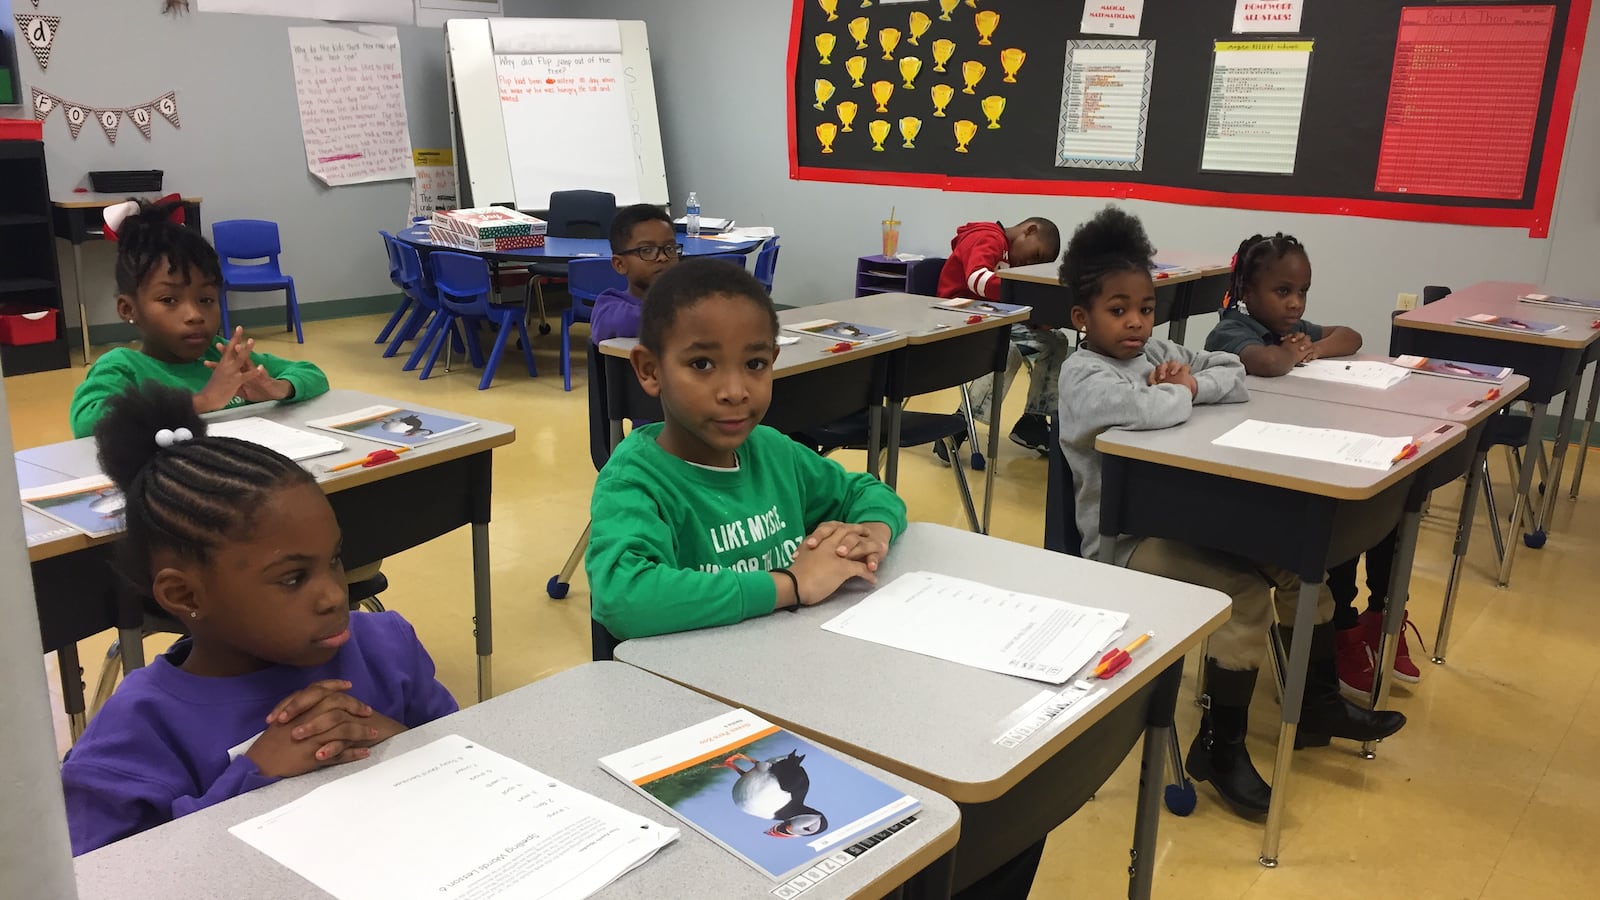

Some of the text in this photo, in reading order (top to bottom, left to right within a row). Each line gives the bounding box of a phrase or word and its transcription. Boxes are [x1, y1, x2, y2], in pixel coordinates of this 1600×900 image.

[1426, 9, 1452, 24] Read
[499, 56, 612, 69] Why did Flip jump out of the
[419, 193, 432, 202] The
[710, 520, 749, 554] LIKE
[504, 833, 541, 855] Spelling
[477, 853, 508, 871] Words
[448, 869, 479, 888] Lesson
